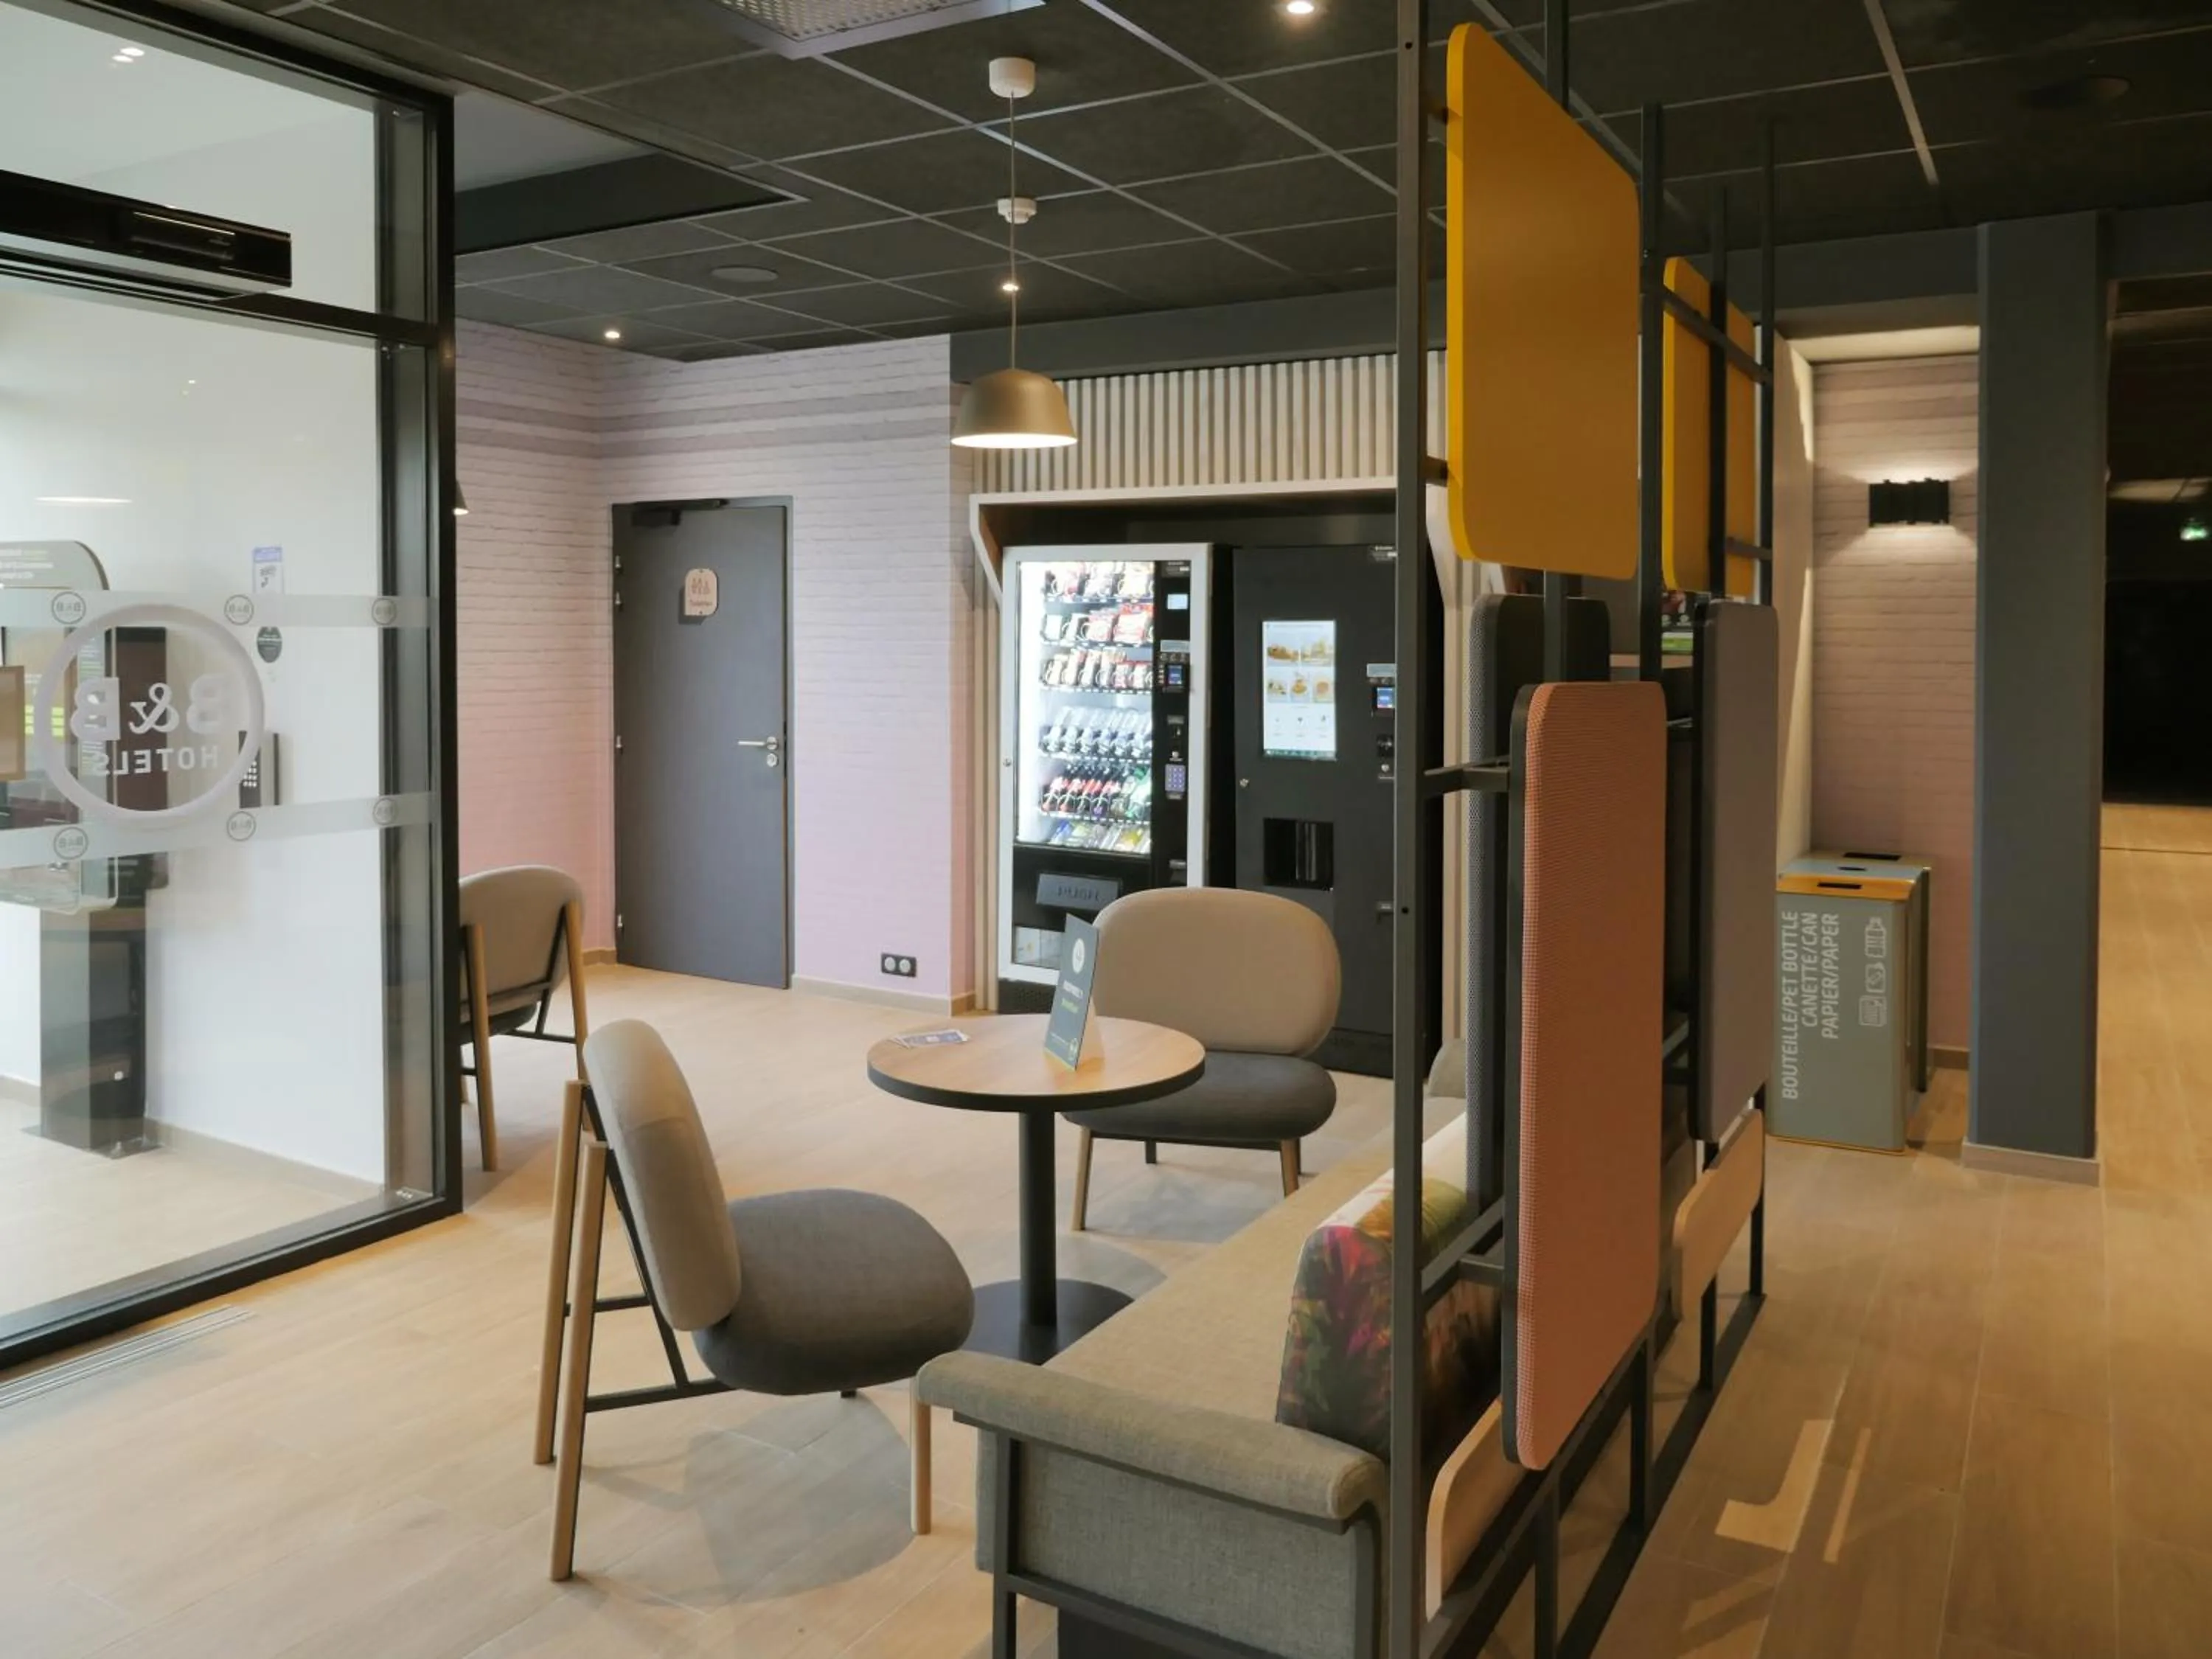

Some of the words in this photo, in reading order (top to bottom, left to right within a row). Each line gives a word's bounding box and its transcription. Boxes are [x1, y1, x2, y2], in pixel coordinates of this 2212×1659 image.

[1781, 911, 1798, 972] BOTTLE
[1801, 912, 1818, 1027] CANETTE/CAN
[1820, 913, 1840, 1040] PAPIER/PAPER
[1781, 975, 1798, 1099] BOUTEILLE/PET
